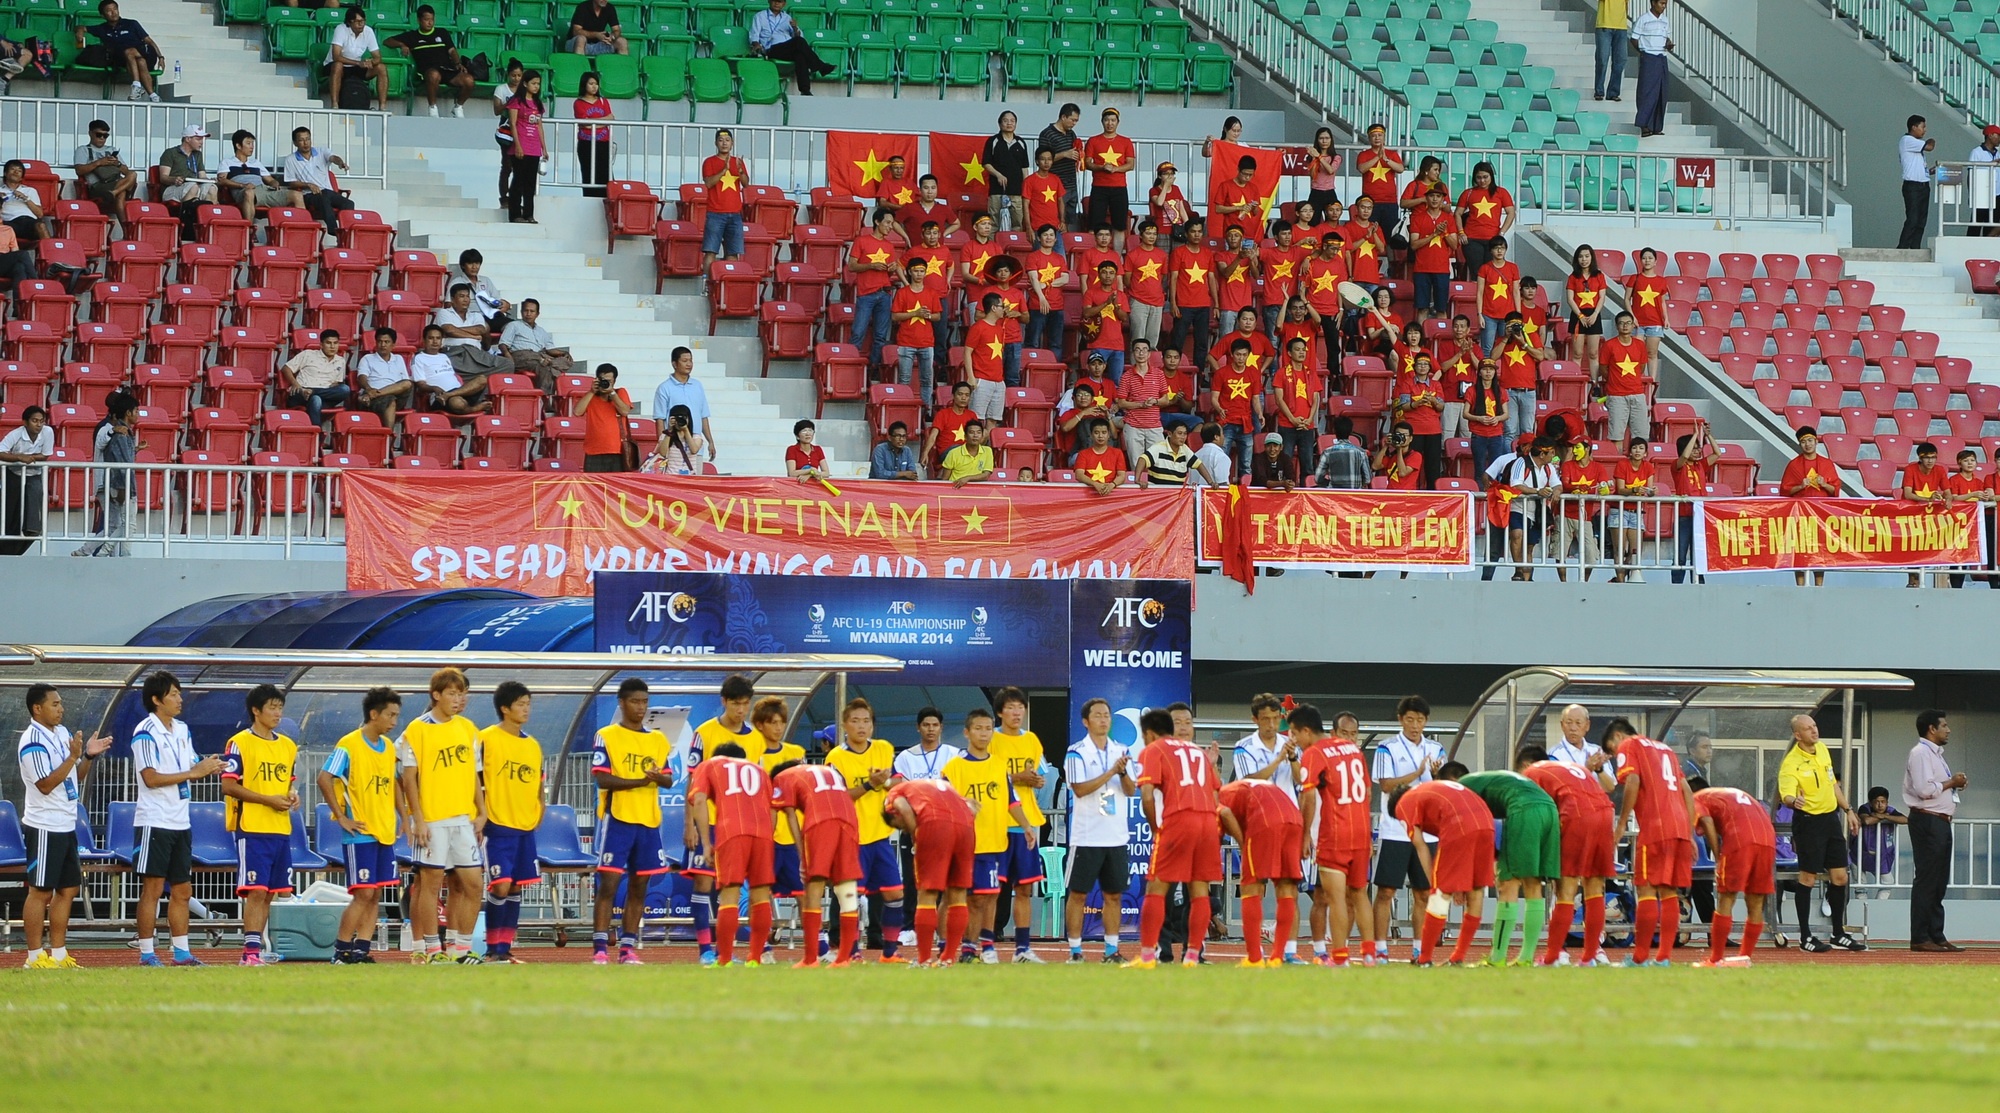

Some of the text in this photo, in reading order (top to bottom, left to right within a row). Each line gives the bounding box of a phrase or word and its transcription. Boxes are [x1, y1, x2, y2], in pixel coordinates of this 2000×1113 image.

[1681, 165, 1711, 180] W-4
[618, 492, 928, 539] U19 VIETNAM
[1277, 514, 1338, 546] NAM
[1345, 502, 1402, 547] TIẾN
[1411, 509, 1457, 548] LÊN
[1716, 510, 1762, 565] VIỆT
[1768, 516, 1820, 555] NAM
[1825, 503, 1892, 553] CHIẾN
[411, 543, 566, 582] SPREAD
[628, 591, 697, 623] AFC
[886, 601, 915, 615] AFC
[1101, 597, 1165, 628] AFC
[832, 618, 967, 630] AFC U-19 CHAMPIONSHIP
[850, 632, 918, 644] MYANMAR
[921, 633, 953, 645] 2014
[1083, 649, 1182, 668] WELCOME
[252, 761, 288, 782] AFC
[432, 744, 471, 772] AFC
[1174, 748, 1205, 787] 17
[1661, 753, 1678, 792] 4
[722, 762, 761, 797] 10
[805, 765, 847, 793] 11
[964, 781, 1000, 802] AFC
[1335, 758, 1366, 805] 18
[675, 906, 691, 914] ONE
